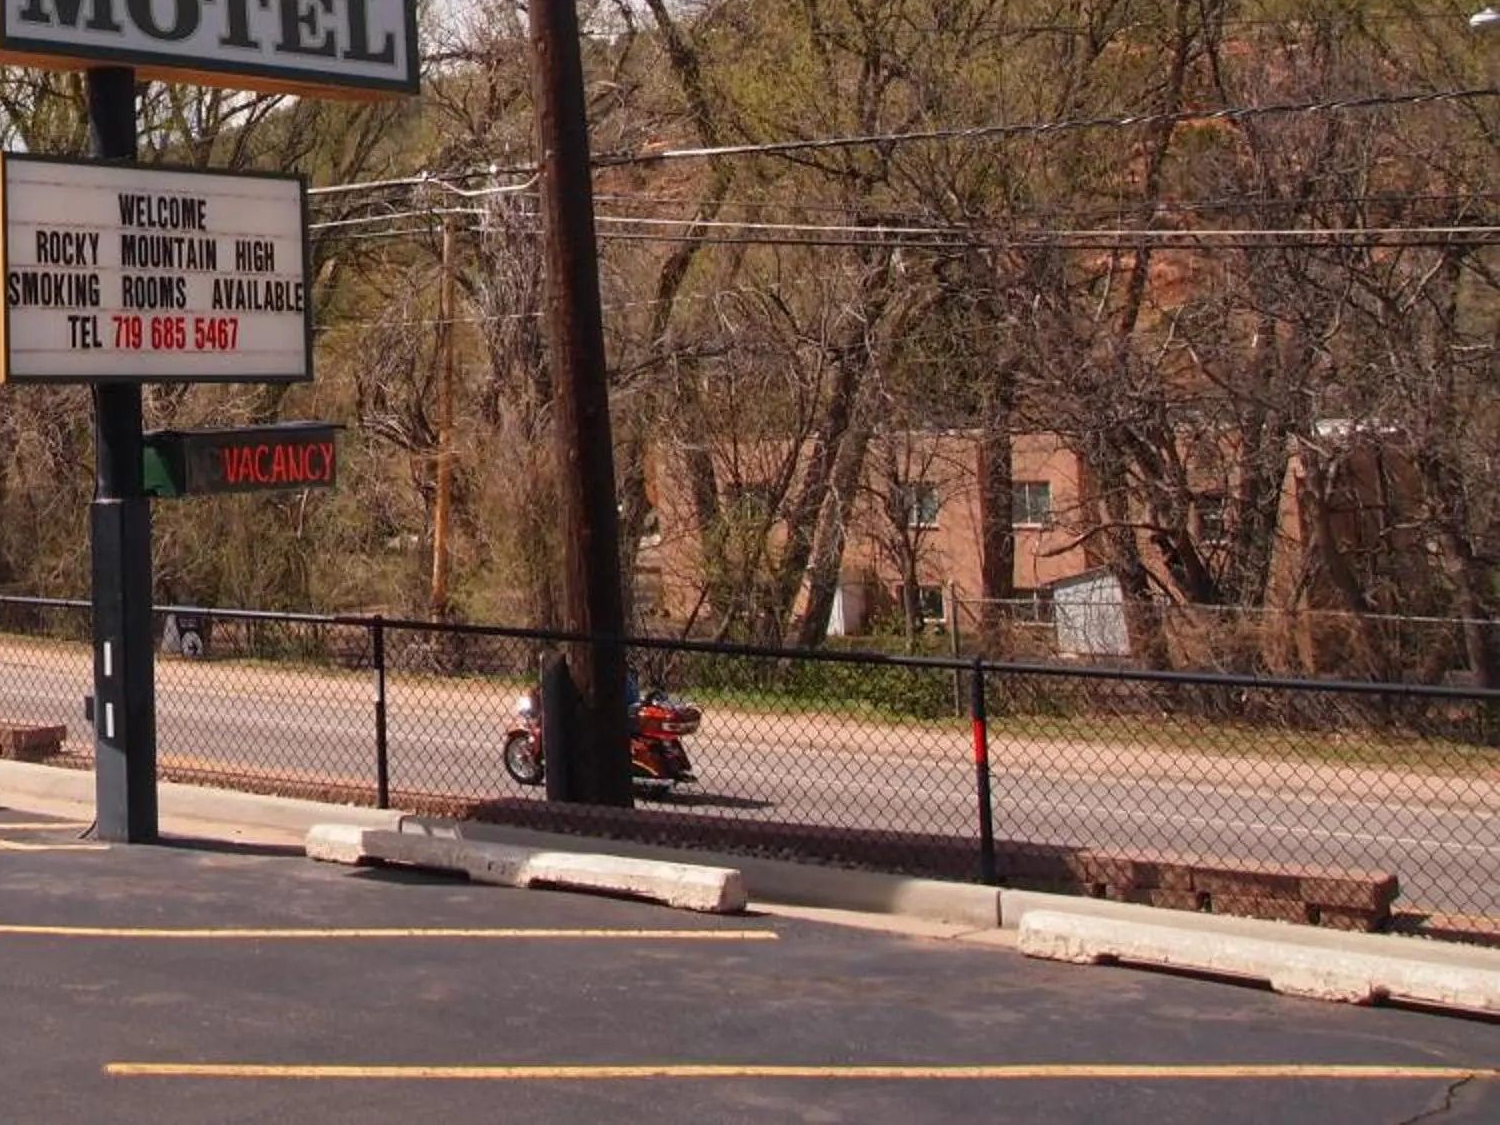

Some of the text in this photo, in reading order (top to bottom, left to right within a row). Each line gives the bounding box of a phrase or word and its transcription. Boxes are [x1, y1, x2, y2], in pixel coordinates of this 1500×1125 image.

[118, 193, 206, 231] WELCOME
[36, 230, 275, 272] ROCKY MOUNTAIN HIGH
[8, 271, 304, 312] SMOKING ROOMS AVAILABLE
[68, 315, 238, 350] TEL 719 685 5467
[224, 442, 334, 483] VACANCY
